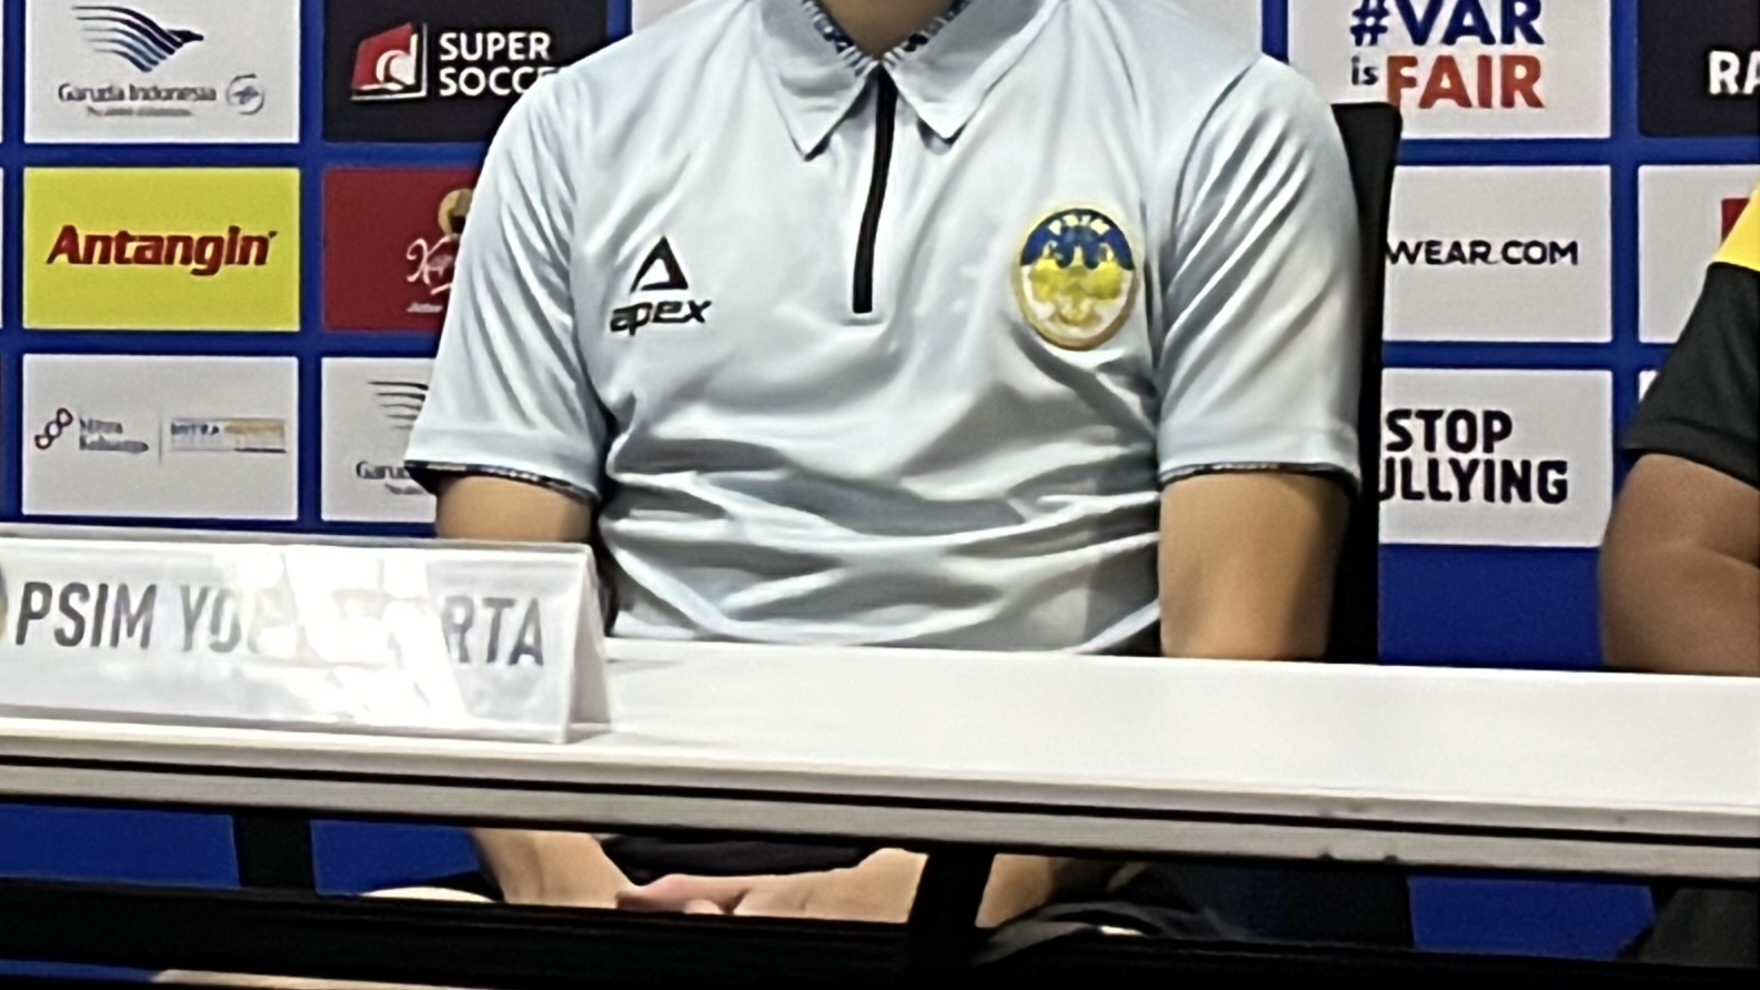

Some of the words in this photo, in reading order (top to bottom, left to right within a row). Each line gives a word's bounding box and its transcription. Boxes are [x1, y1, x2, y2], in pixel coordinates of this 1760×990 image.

[439, 31, 551, 61] SUPER
[439, 66, 570, 96] SOCC
[1351, 56, 1379, 86] is
[1386, 54, 1546, 109] FAIR
[47, 225, 270, 276] Antangin
[1386, 239, 1579, 266] WEAR.COM
[1385, 408, 1513, 454] STOP
[1380, 459, 1569, 505] ULLYING
[15, 579, 159, 651] PSIM
[180, 584, 546, 669] YORTA
